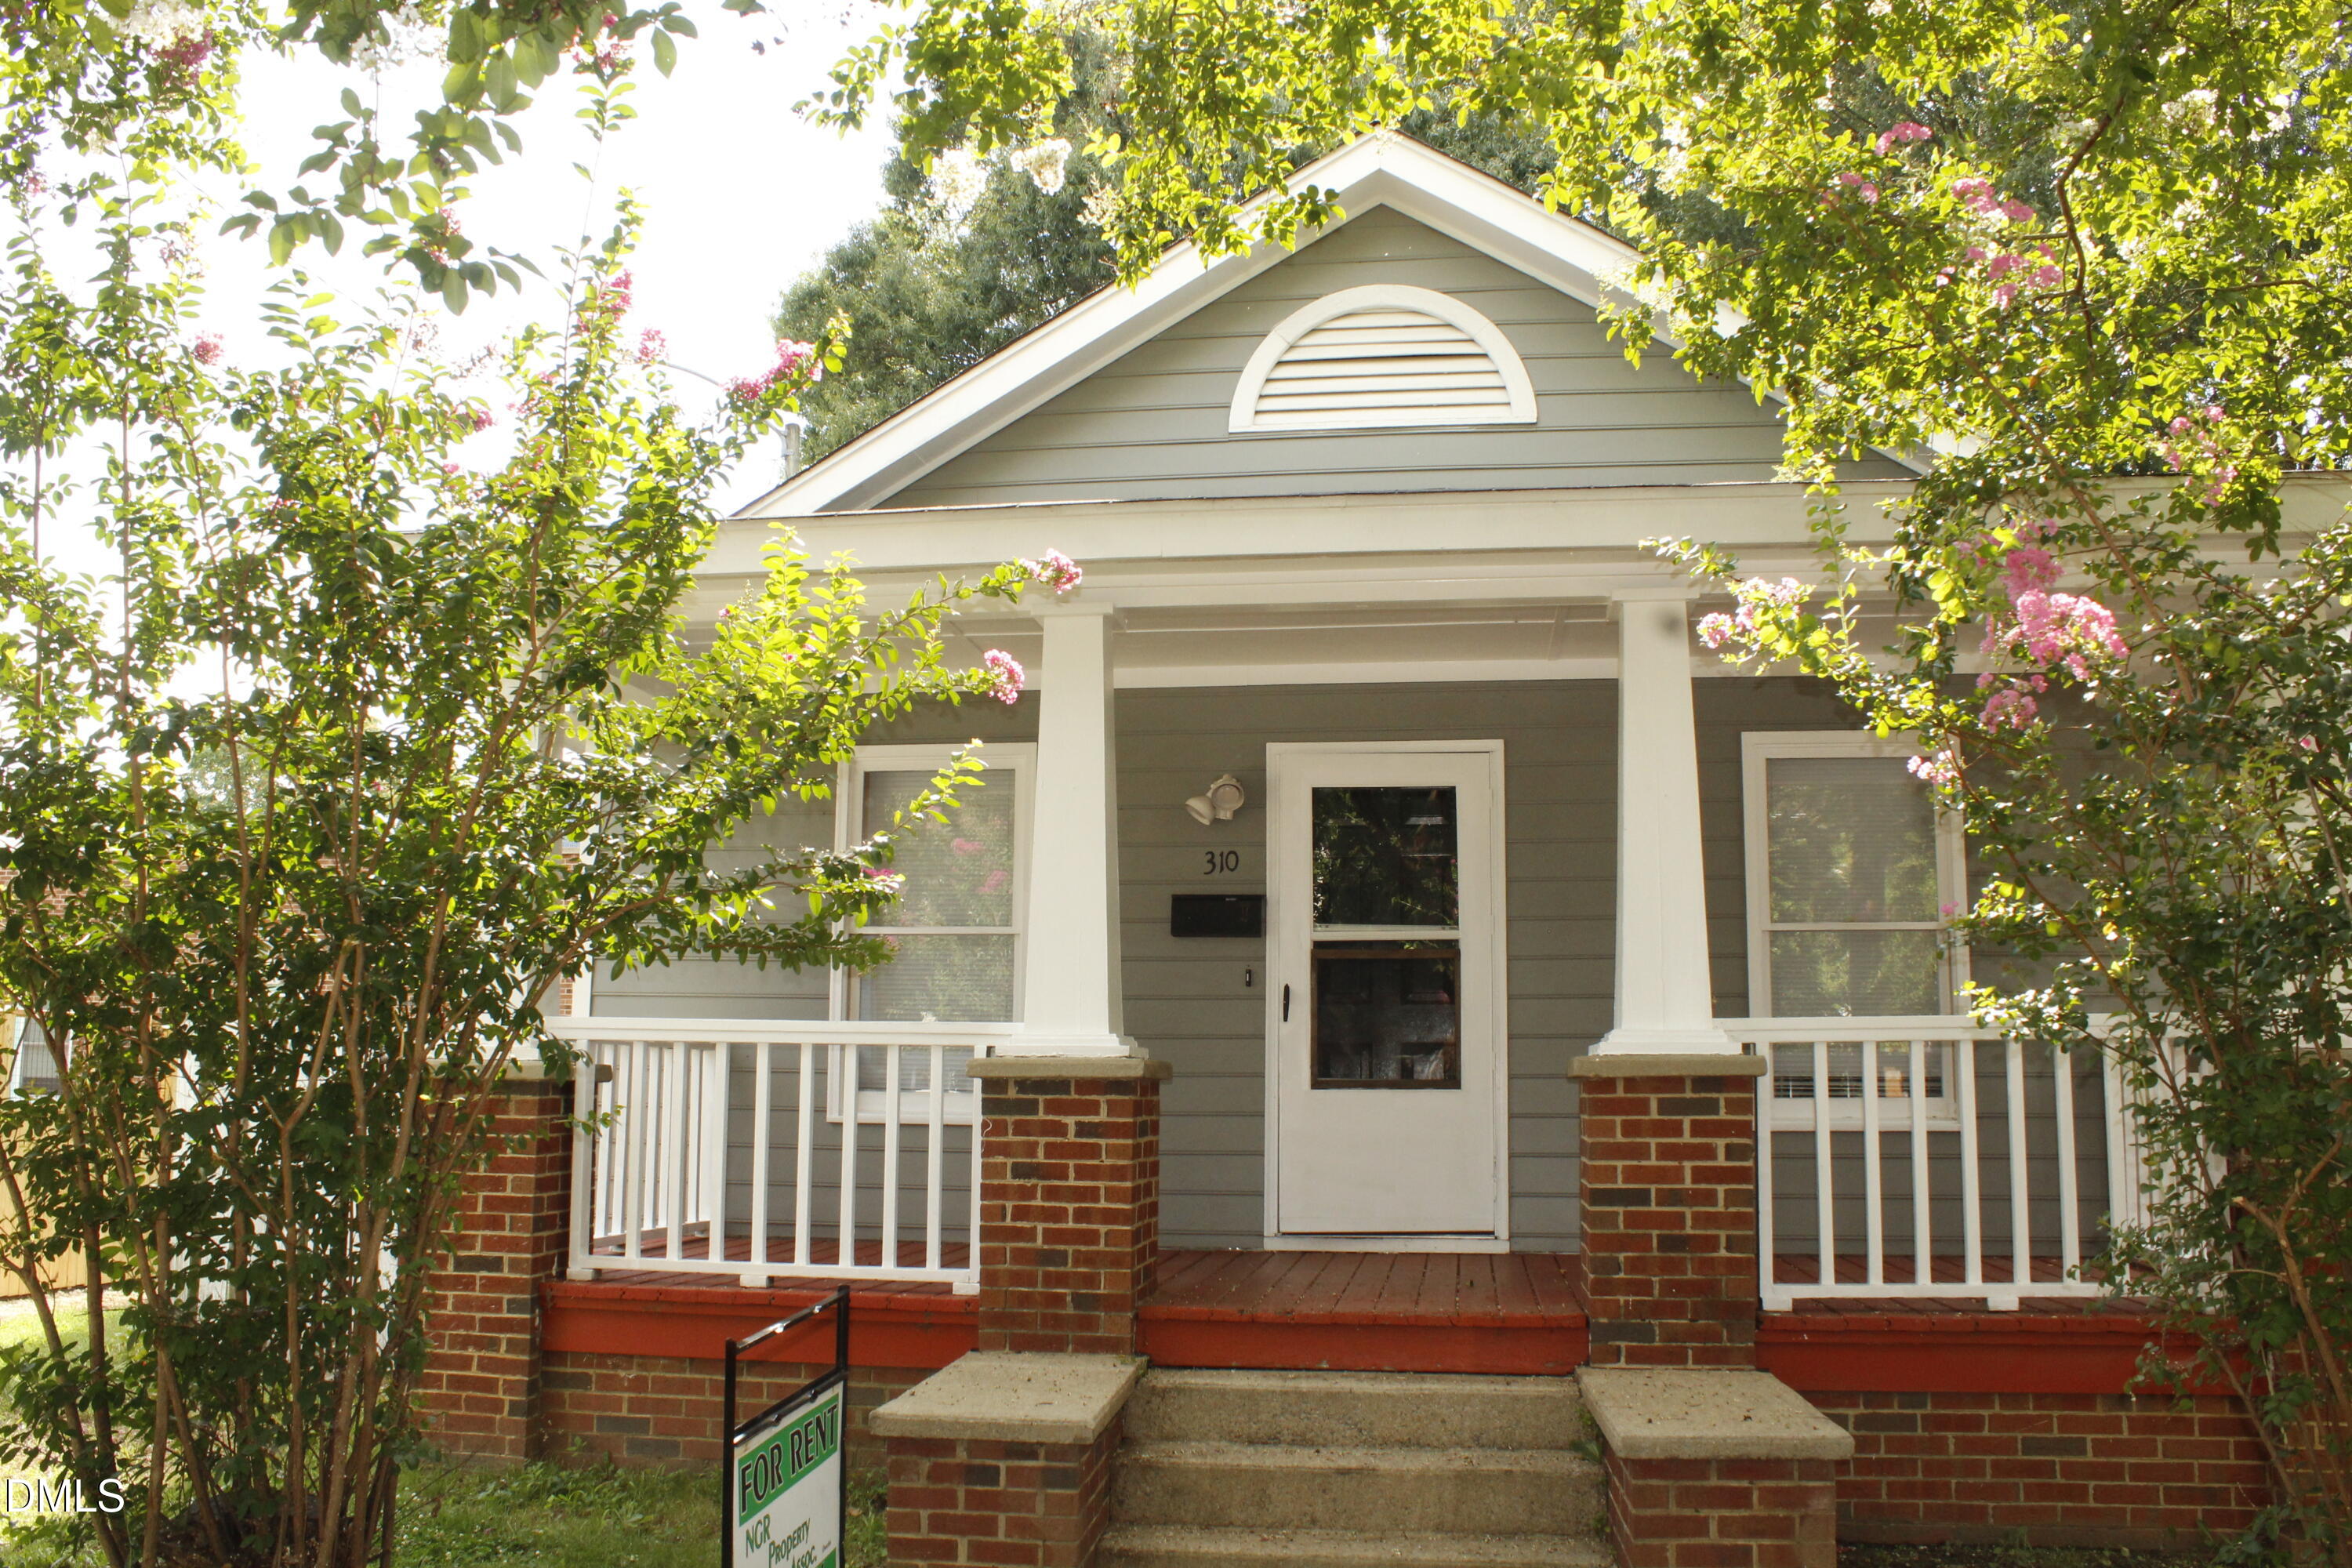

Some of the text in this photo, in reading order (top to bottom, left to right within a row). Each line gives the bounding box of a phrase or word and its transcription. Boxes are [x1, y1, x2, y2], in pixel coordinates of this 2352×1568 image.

[1203, 851, 1239, 875] 310
[741, 1404, 837, 1513] FOR RENT
[746, 1514, 771, 1558] NGR
